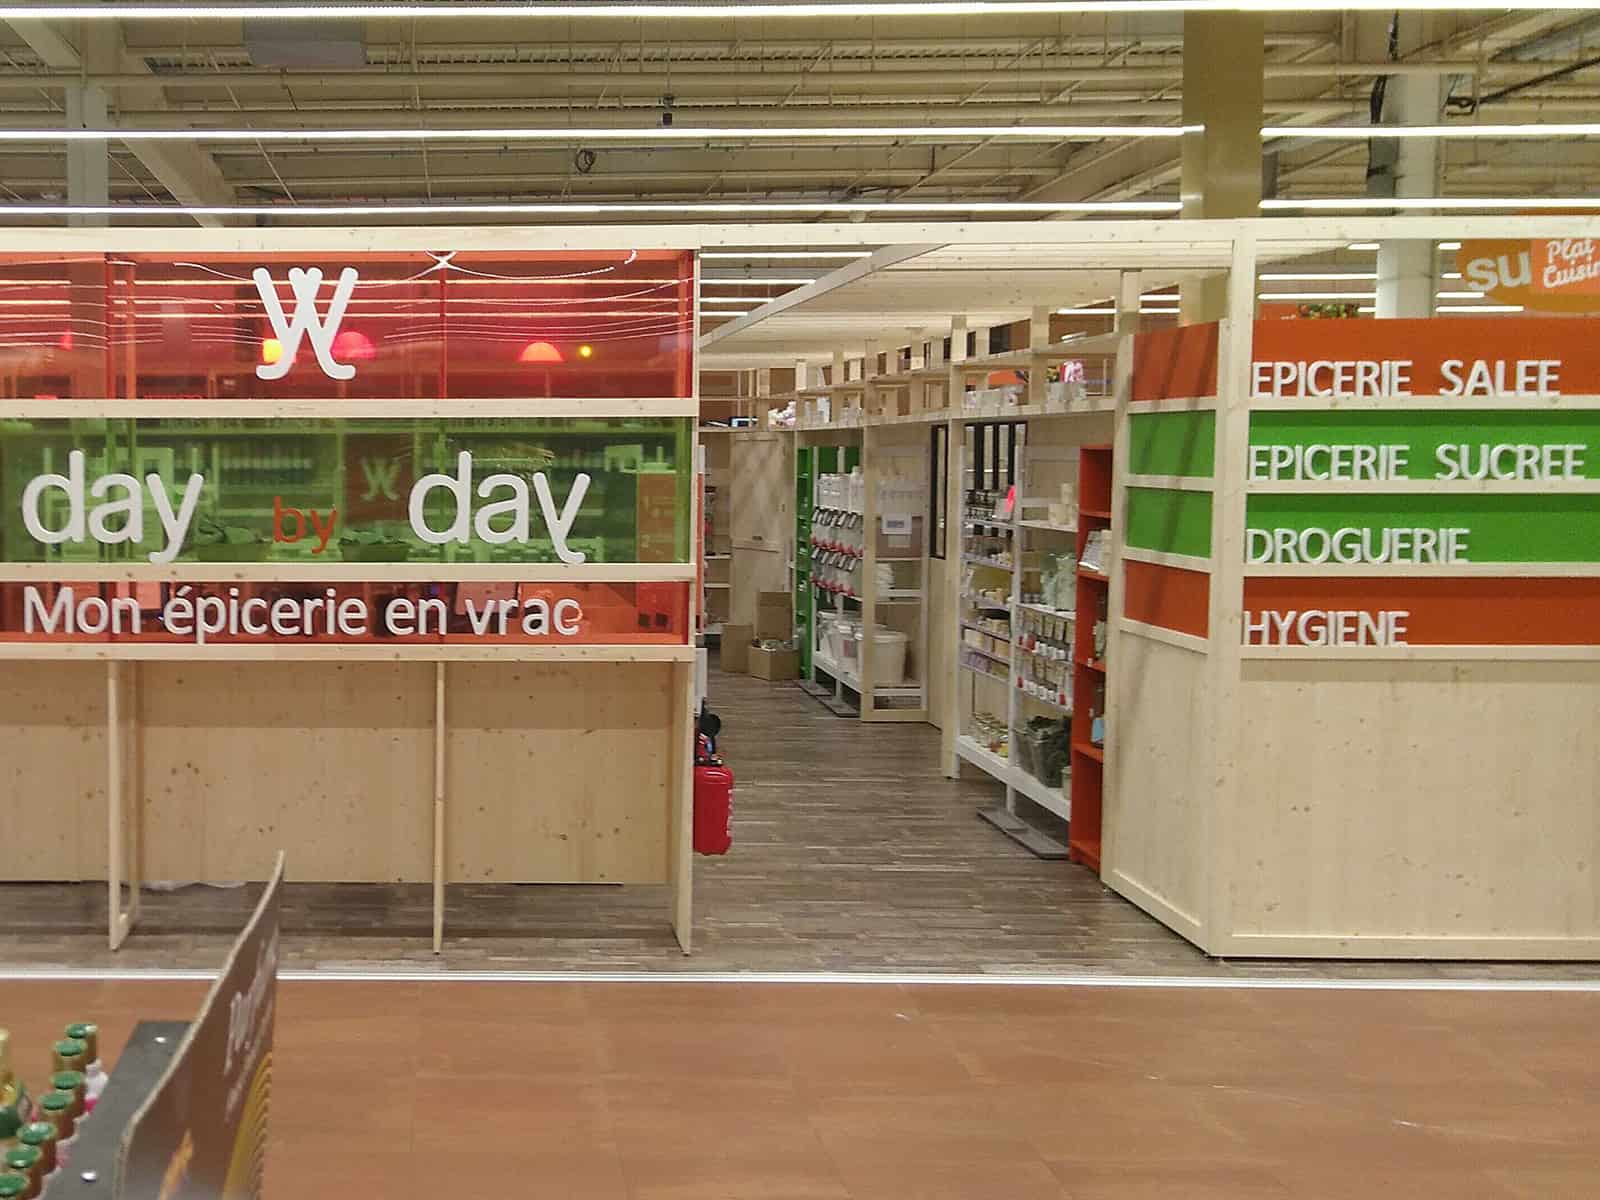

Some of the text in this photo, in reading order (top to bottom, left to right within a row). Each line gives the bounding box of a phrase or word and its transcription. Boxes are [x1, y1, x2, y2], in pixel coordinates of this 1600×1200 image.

[1251, 359, 1562, 398] EPICERIE SALEE
[1248, 443, 1587, 482] EPICERIE SUCREE
[21, 450, 591, 565] day by day
[1245, 527, 1470, 565] DROGUERIE
[23, 586, 582, 646] Mon épicerie en vrac
[1243, 610, 1410, 648] HYGIENE
